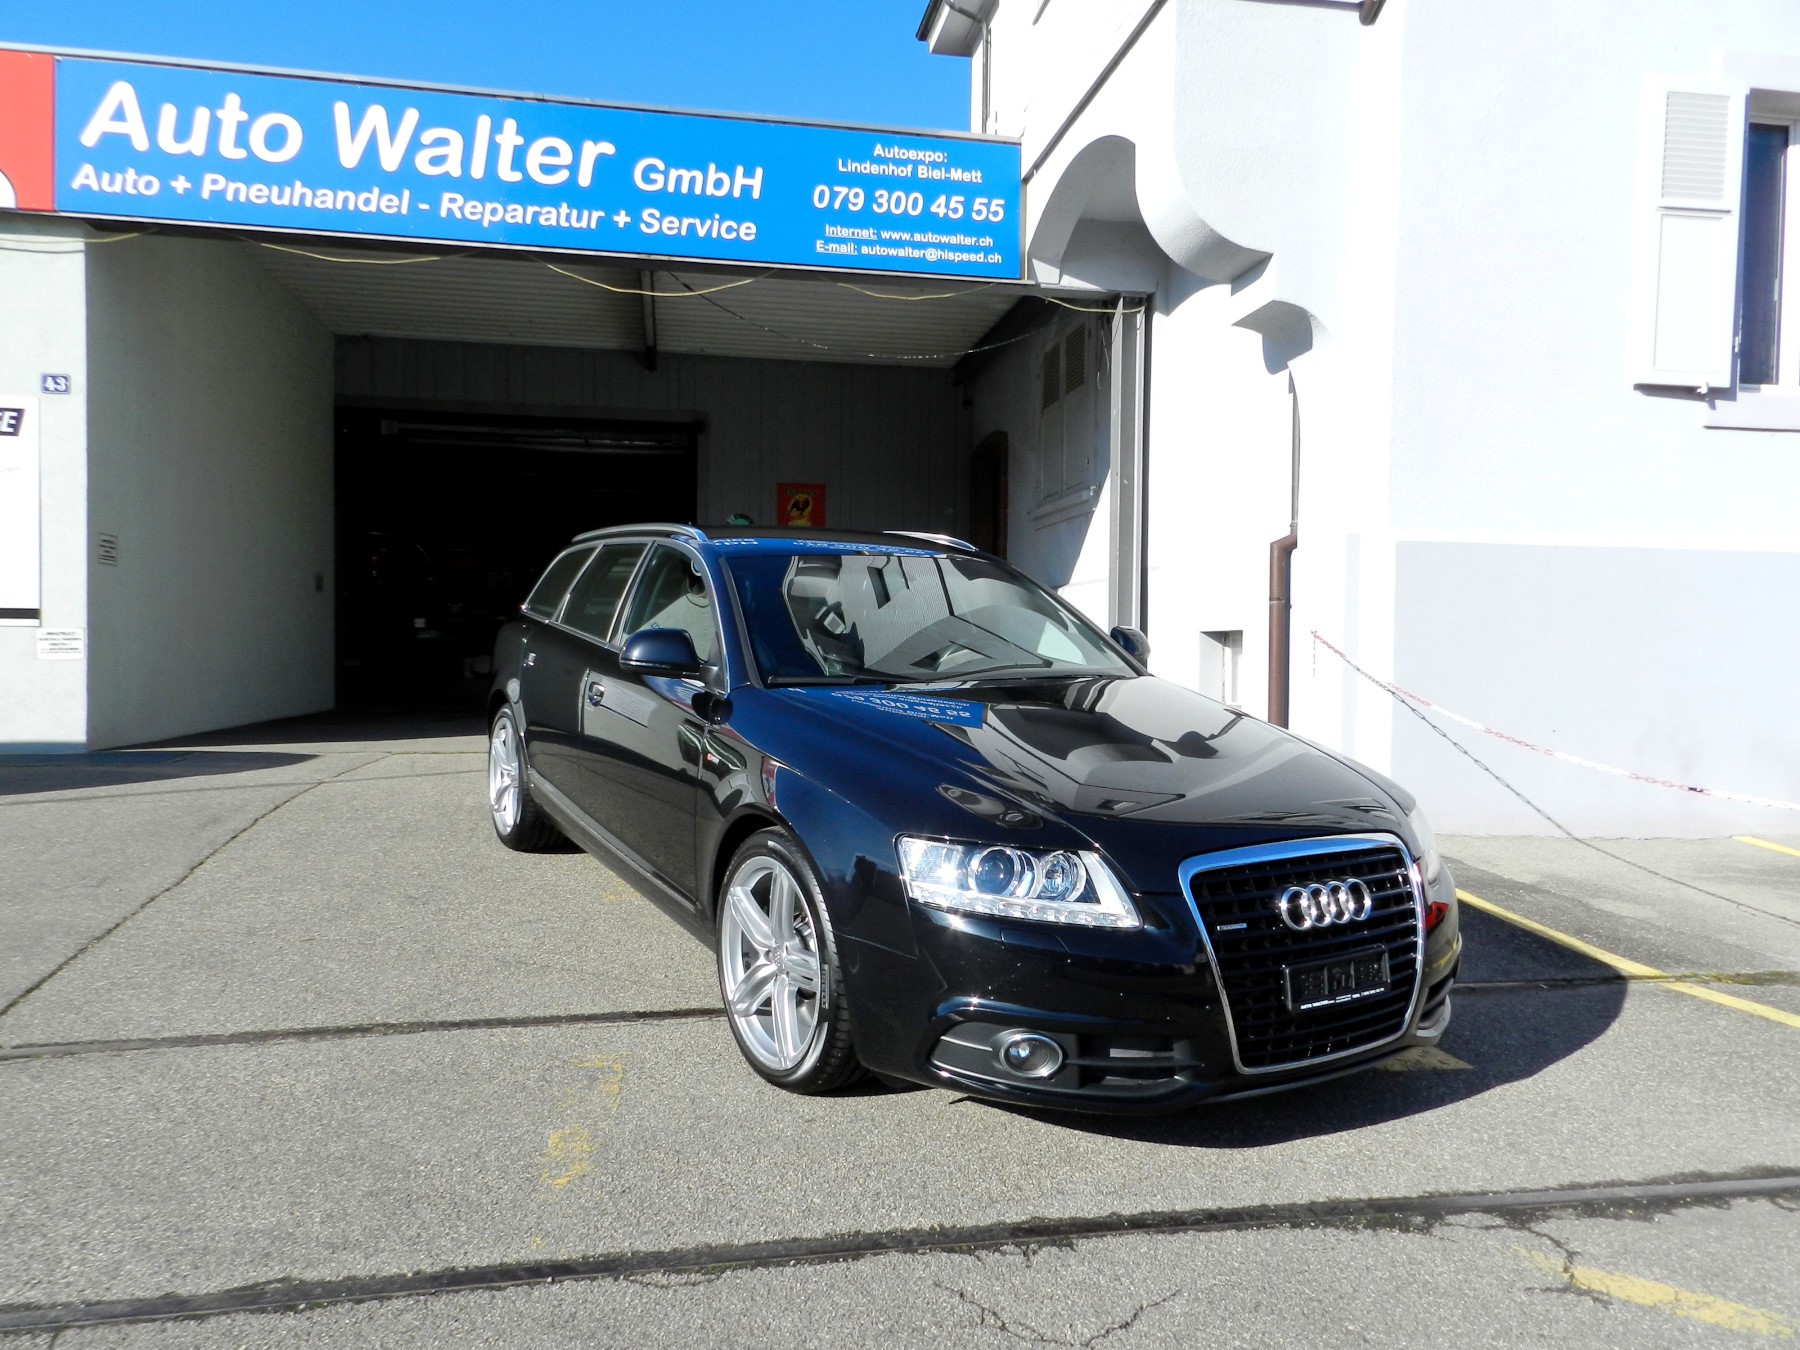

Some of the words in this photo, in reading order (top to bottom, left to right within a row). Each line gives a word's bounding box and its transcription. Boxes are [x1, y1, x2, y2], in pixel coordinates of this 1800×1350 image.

[80, 81, 302, 163] Auto
[334, 101, 616, 187] Walter
[633, 158, 763, 200] GmbH
[874, 144, 947, 164] Autoexpo:
[838, 158, 913, 177] Lindenhof
[918, 166, 982, 183] Biel-Mett
[71, 163, 160, 195] Auto
[170, 175, 191, 194] +
[202, 173, 410, 216] Pneuhandel
[440, 193, 605, 228] Reparatur
[613, 210, 631, 228] +
[640, 208, 757, 241] Service
[813, 185, 865, 212] 079
[872, 190, 924, 216] 300
[930, 194, 965, 220] 45
[971, 198, 1005, 222] 55
[825, 224, 878, 240] Internet:
[880, 231, 993, 247] www.autowalter.ch
[816, 240, 858, 255] E-mail:
[861, 244, 1002, 264] autowalter@hispeed.ch
[45, 376, 68, 392] 43
